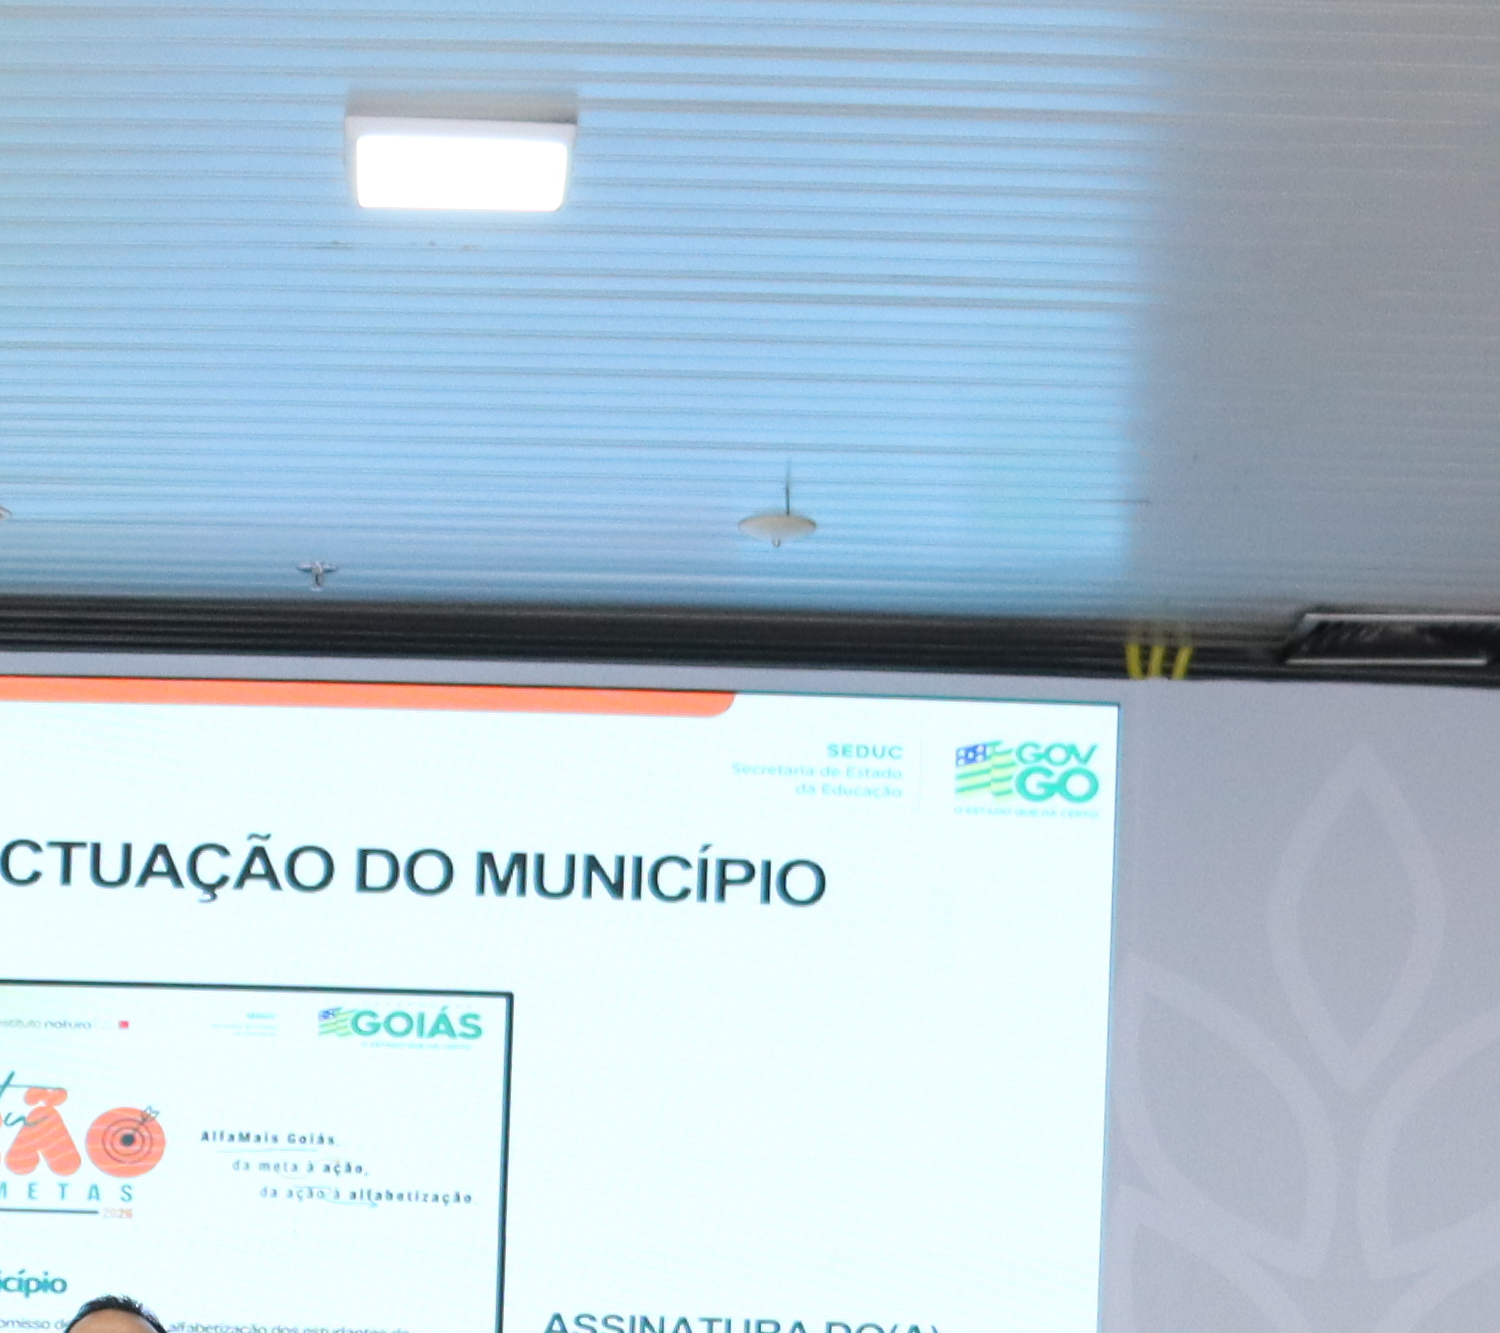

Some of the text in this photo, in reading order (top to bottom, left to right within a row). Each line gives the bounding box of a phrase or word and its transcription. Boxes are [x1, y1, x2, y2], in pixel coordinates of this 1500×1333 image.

[827, 743, 904, 759] SEDUC
[1014, 742, 1098, 767] GOV
[731, 762, 903, 779] Secretaria de Estado
[795, 783, 903, 799] da Educação
[1014, 765, 1099, 803] GO
[354, 845, 455, 894] DO
[476, 844, 827, 907] MUNICÍPIO
[351, 1006, 483, 1040] GOIÁS
[201, 1131, 279, 1144] AlfaMais
